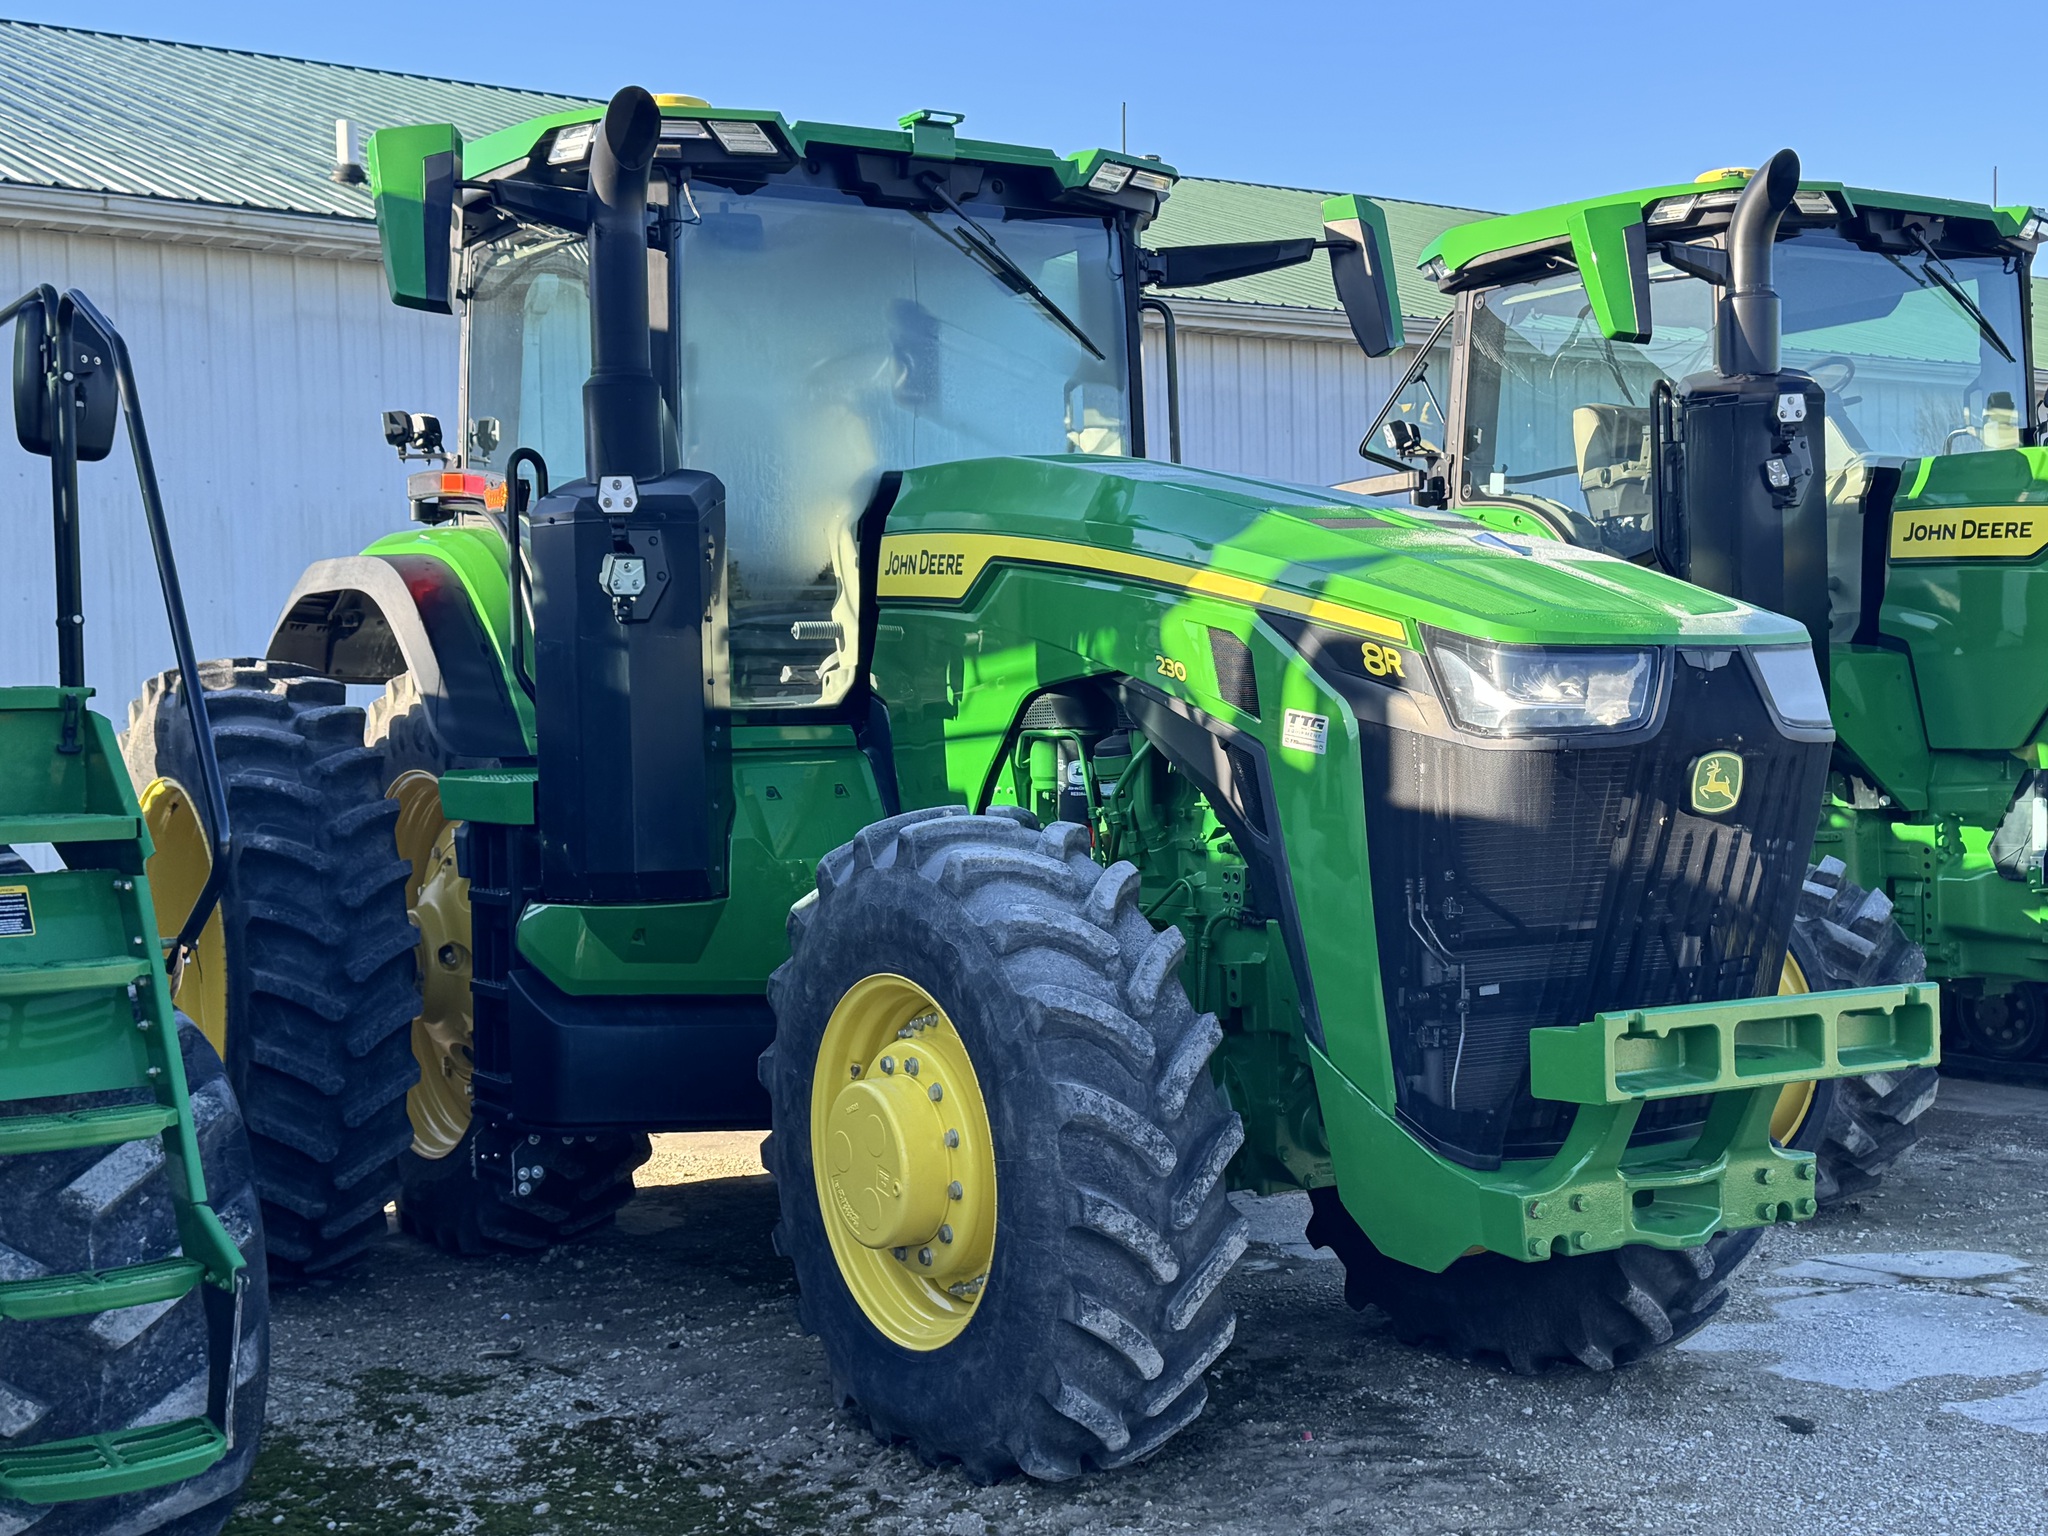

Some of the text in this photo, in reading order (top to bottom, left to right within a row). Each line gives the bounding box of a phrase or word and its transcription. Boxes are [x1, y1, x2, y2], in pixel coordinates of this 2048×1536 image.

[1903, 520, 2033, 542] JOHN DEERE
[885, 550, 964, 575] JOHN DEERE
[1155, 654, 1187, 682] 230
[1361, 641, 1407, 679] 8R
[1288, 713, 1326, 730] TTG
